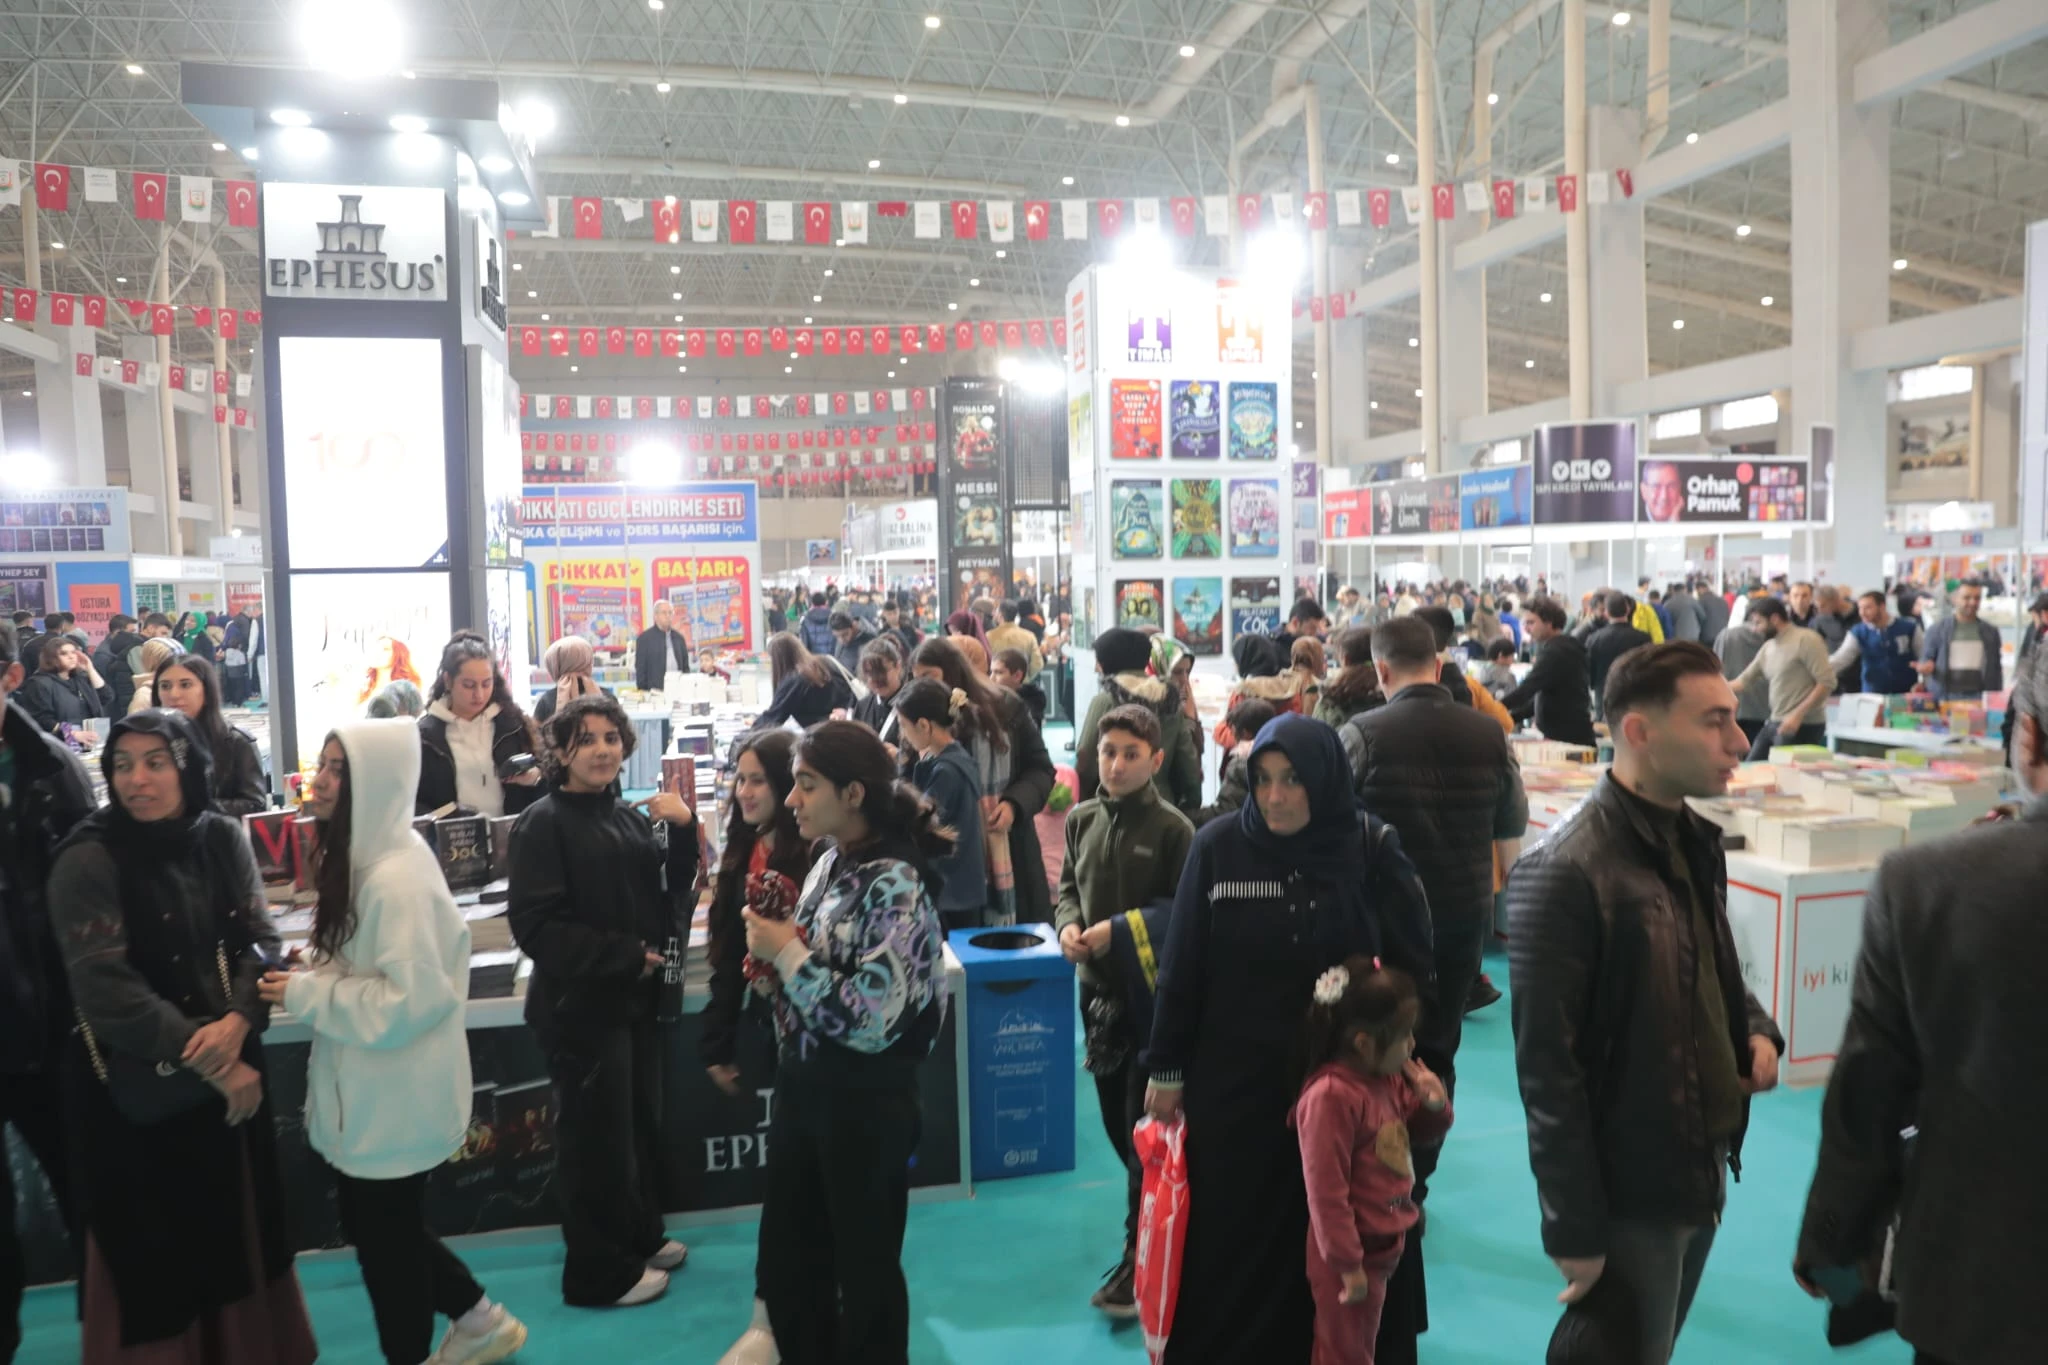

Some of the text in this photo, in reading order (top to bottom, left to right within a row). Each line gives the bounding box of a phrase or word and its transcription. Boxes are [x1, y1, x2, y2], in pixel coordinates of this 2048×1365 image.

[269, 258, 436, 291] EPHESUS
[953, 405, 995, 414] RONALDO
[955, 481, 998, 494] MESSI
[1582, 480, 1633, 492] YAYINLARI
[1687, 473, 1739, 495] Orhan
[1398, 490, 1427, 507] Ahmet
[1687, 495, 1741, 513] Pamuk
[606, 527, 621, 537] ve
[657, 559, 734, 581] BAŞARI
[958, 557, 1000, 569] NEYMAR
[80, 597, 111, 609] USTURA
[1803, 967, 1826, 992] iyi
